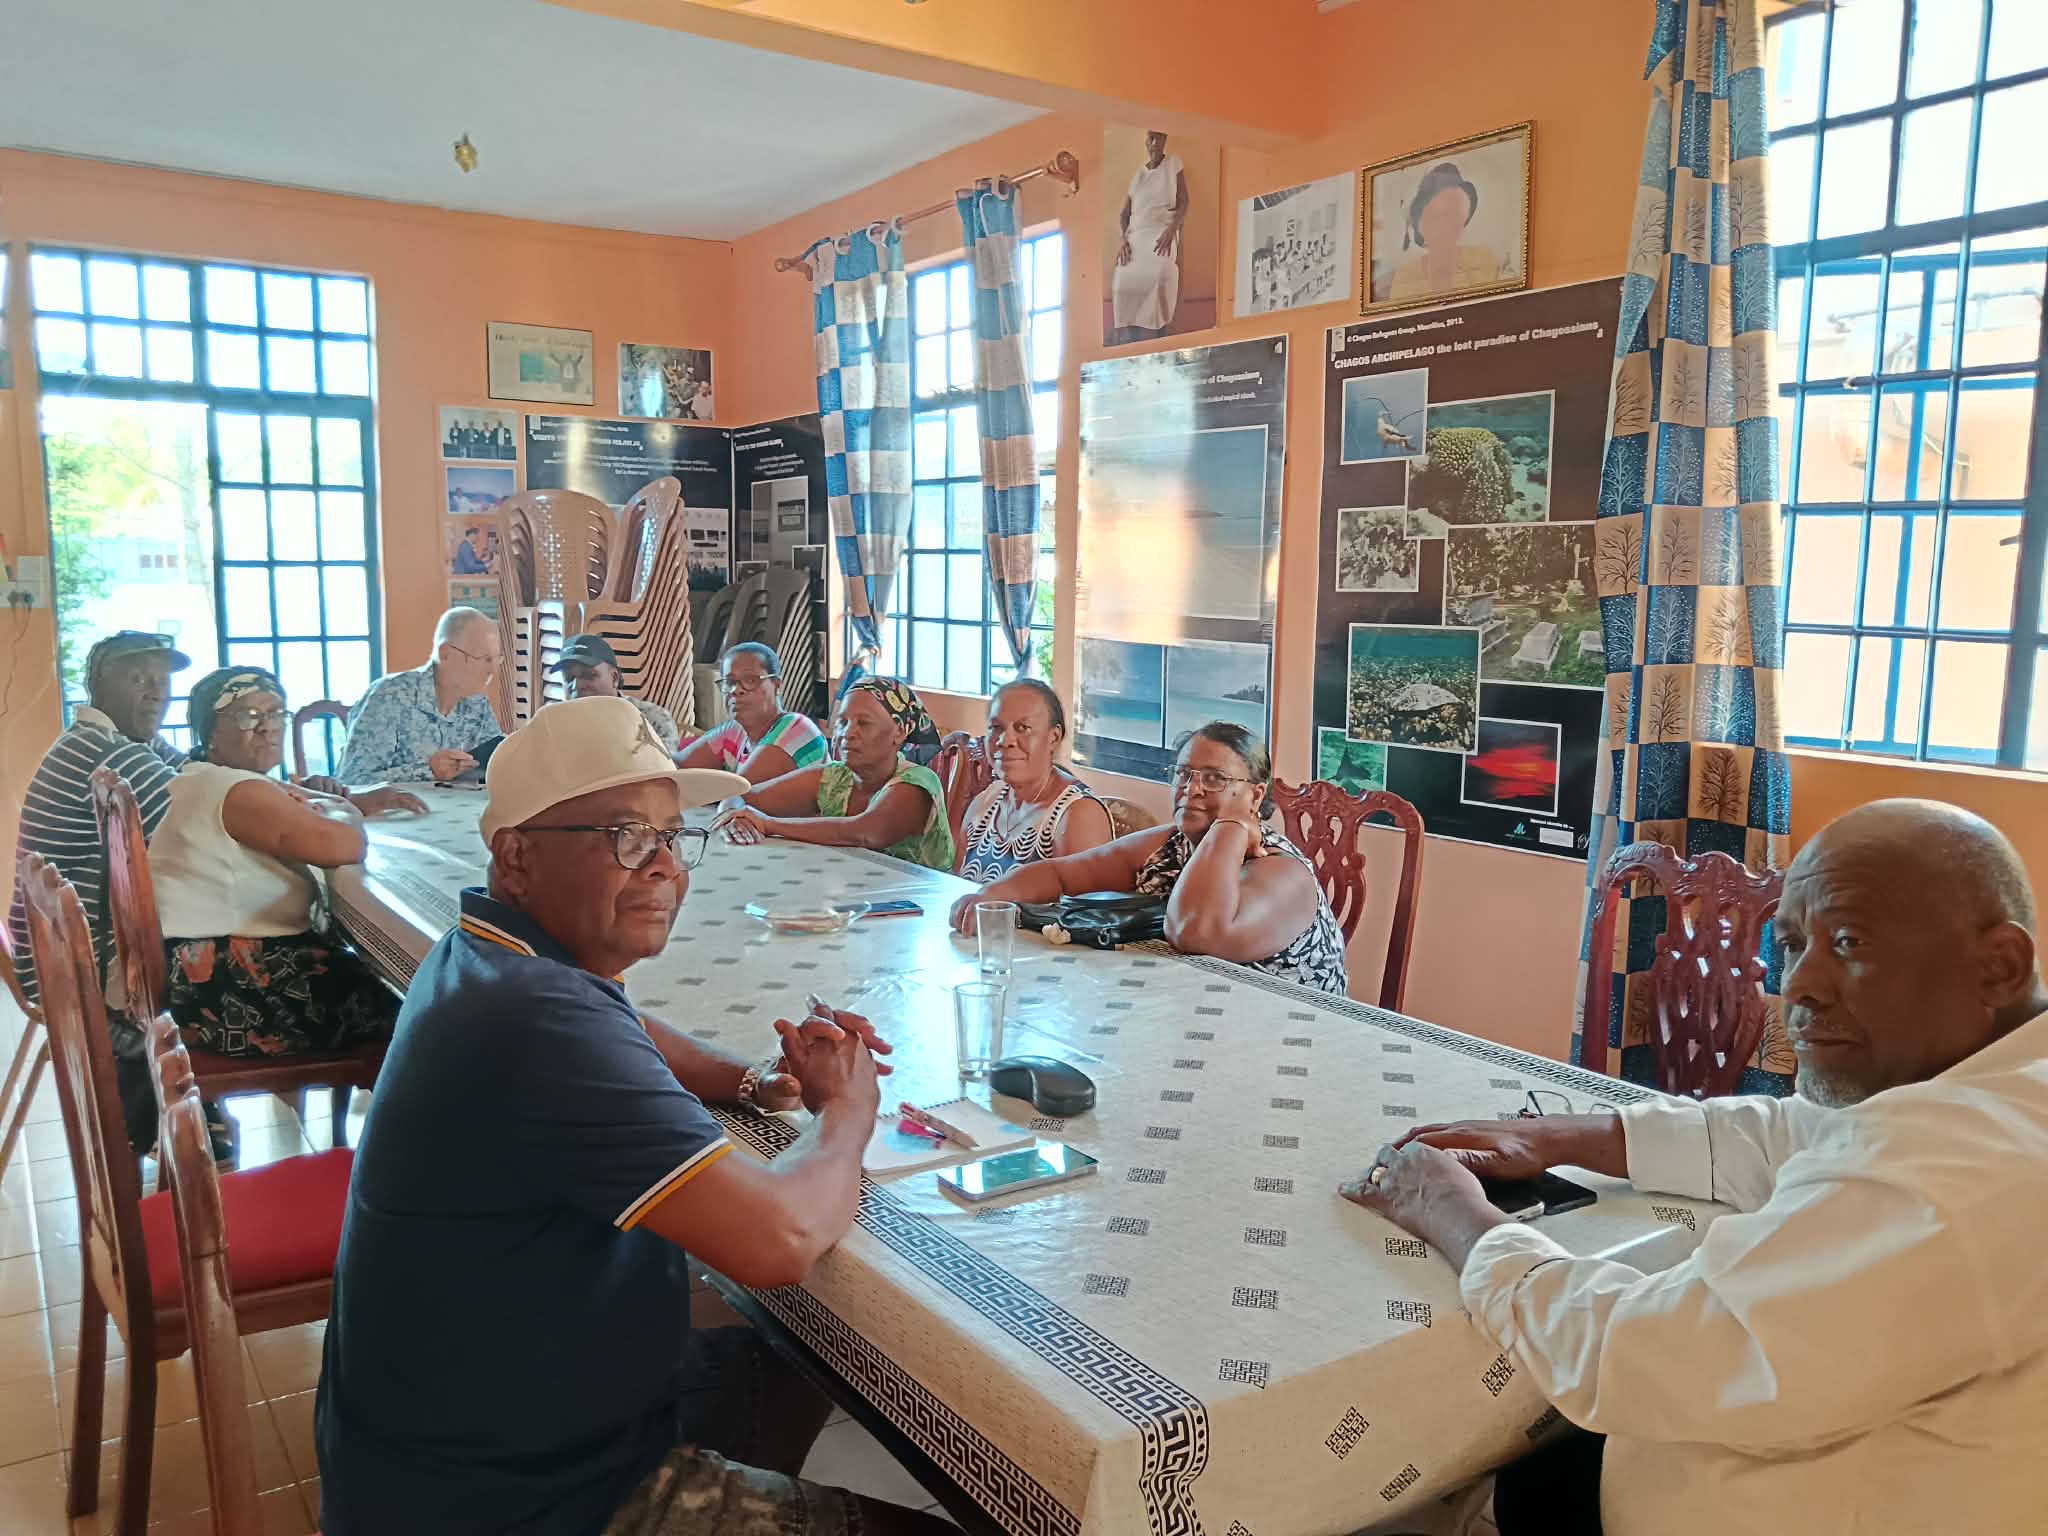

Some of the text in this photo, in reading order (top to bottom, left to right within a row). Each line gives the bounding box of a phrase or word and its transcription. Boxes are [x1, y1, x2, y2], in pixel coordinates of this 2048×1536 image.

[1334, 357, 1370, 369] CHAGOS
[1371, 346, 1435, 364] ARCHIPELAGO
[1436, 343, 1452, 354] the
[1453, 340, 1473, 351] lost
[1473, 334, 1517, 350] paradise
[1519, 330, 1530, 341] of
